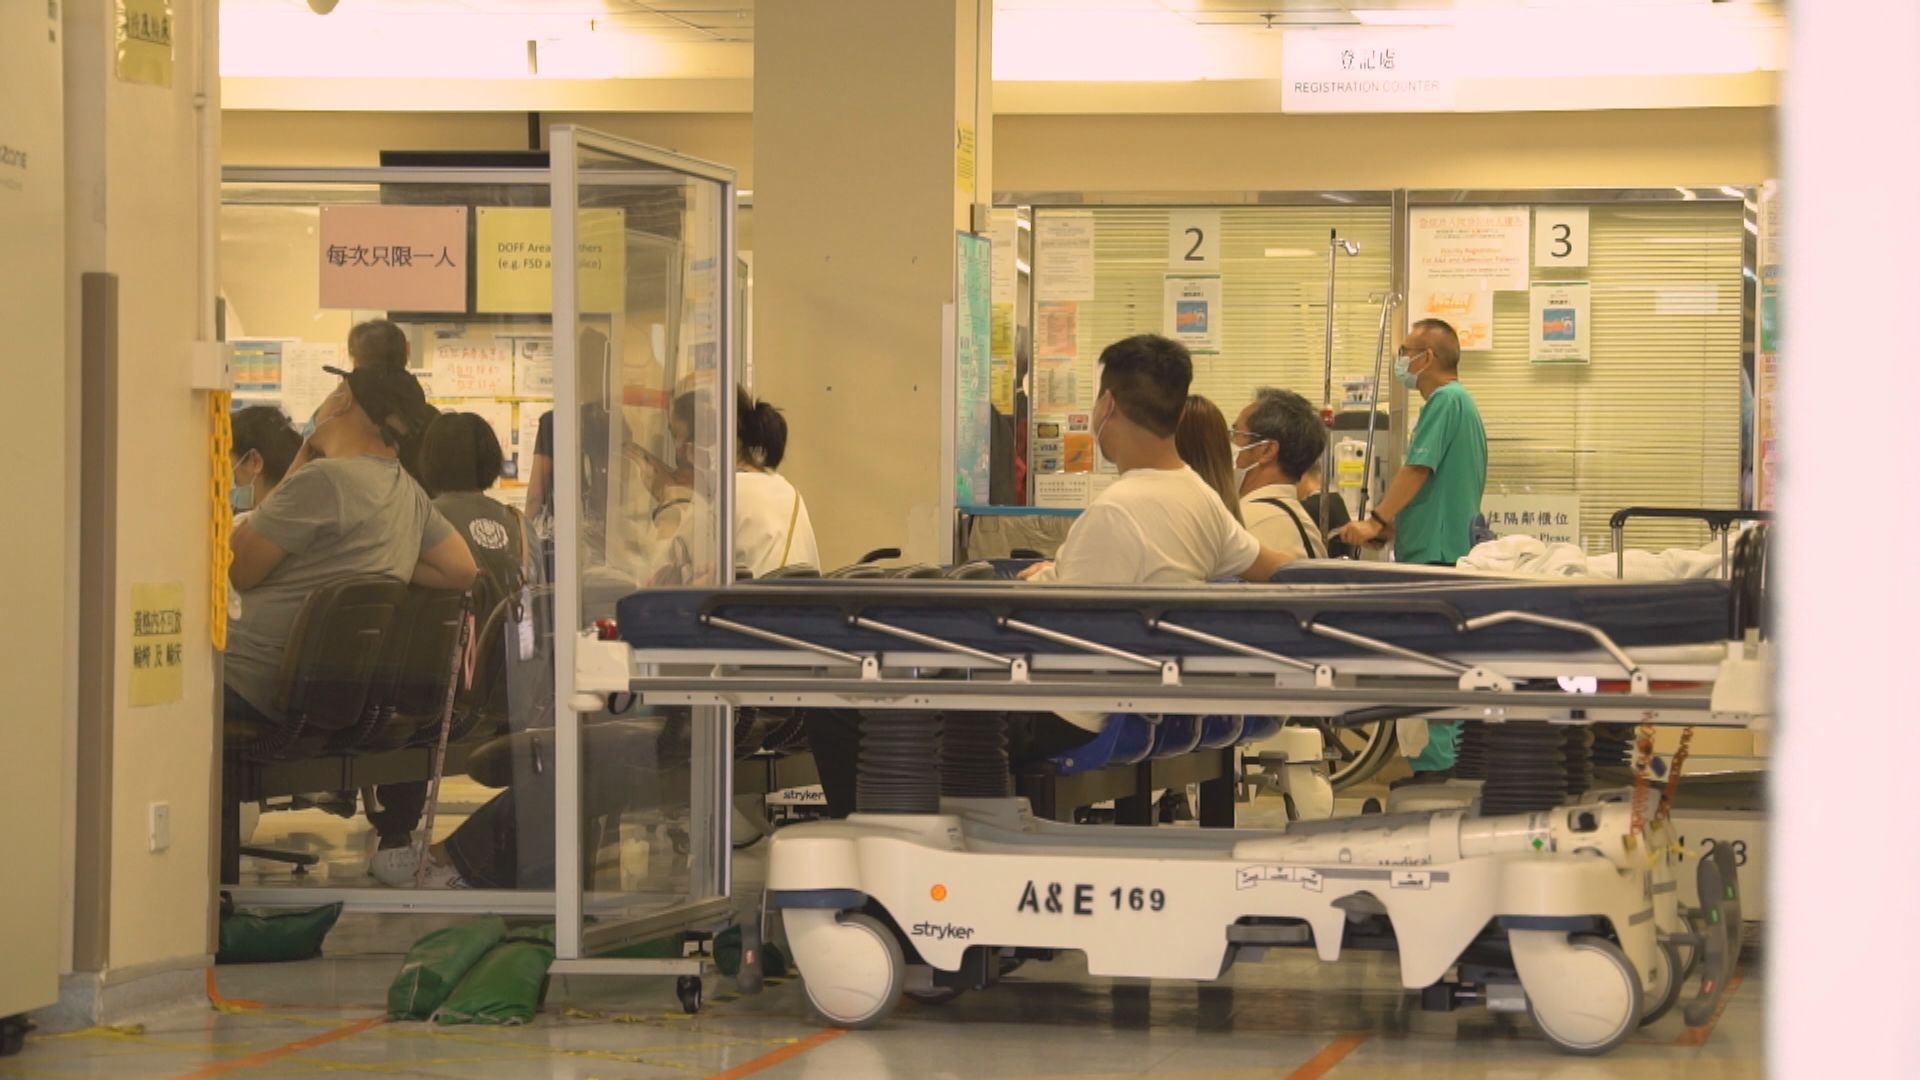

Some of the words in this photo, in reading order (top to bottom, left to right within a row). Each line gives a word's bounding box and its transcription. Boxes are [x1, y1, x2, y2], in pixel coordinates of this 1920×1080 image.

[1294, 82, 1379, 94] REGISTRATION
[1383, 80, 1439, 93] COUNTER
[498, 243, 523, 253] DOFF
[528, 243, 551, 253] Area
[578, 243, 602, 253] thers
[1184, 227, 1204, 261] 2
[1551, 224, 1572, 258] 3
[326, 244, 457, 268] 每次只限一人
[523, 258, 542, 269] FSD
[1540, 532, 1571, 543] Please
[784, 790, 825, 801] stryker
[1017, 880, 1094, 915] A&E
[1109, 887, 1166, 912] 169
[911, 921, 975, 940] stryker
